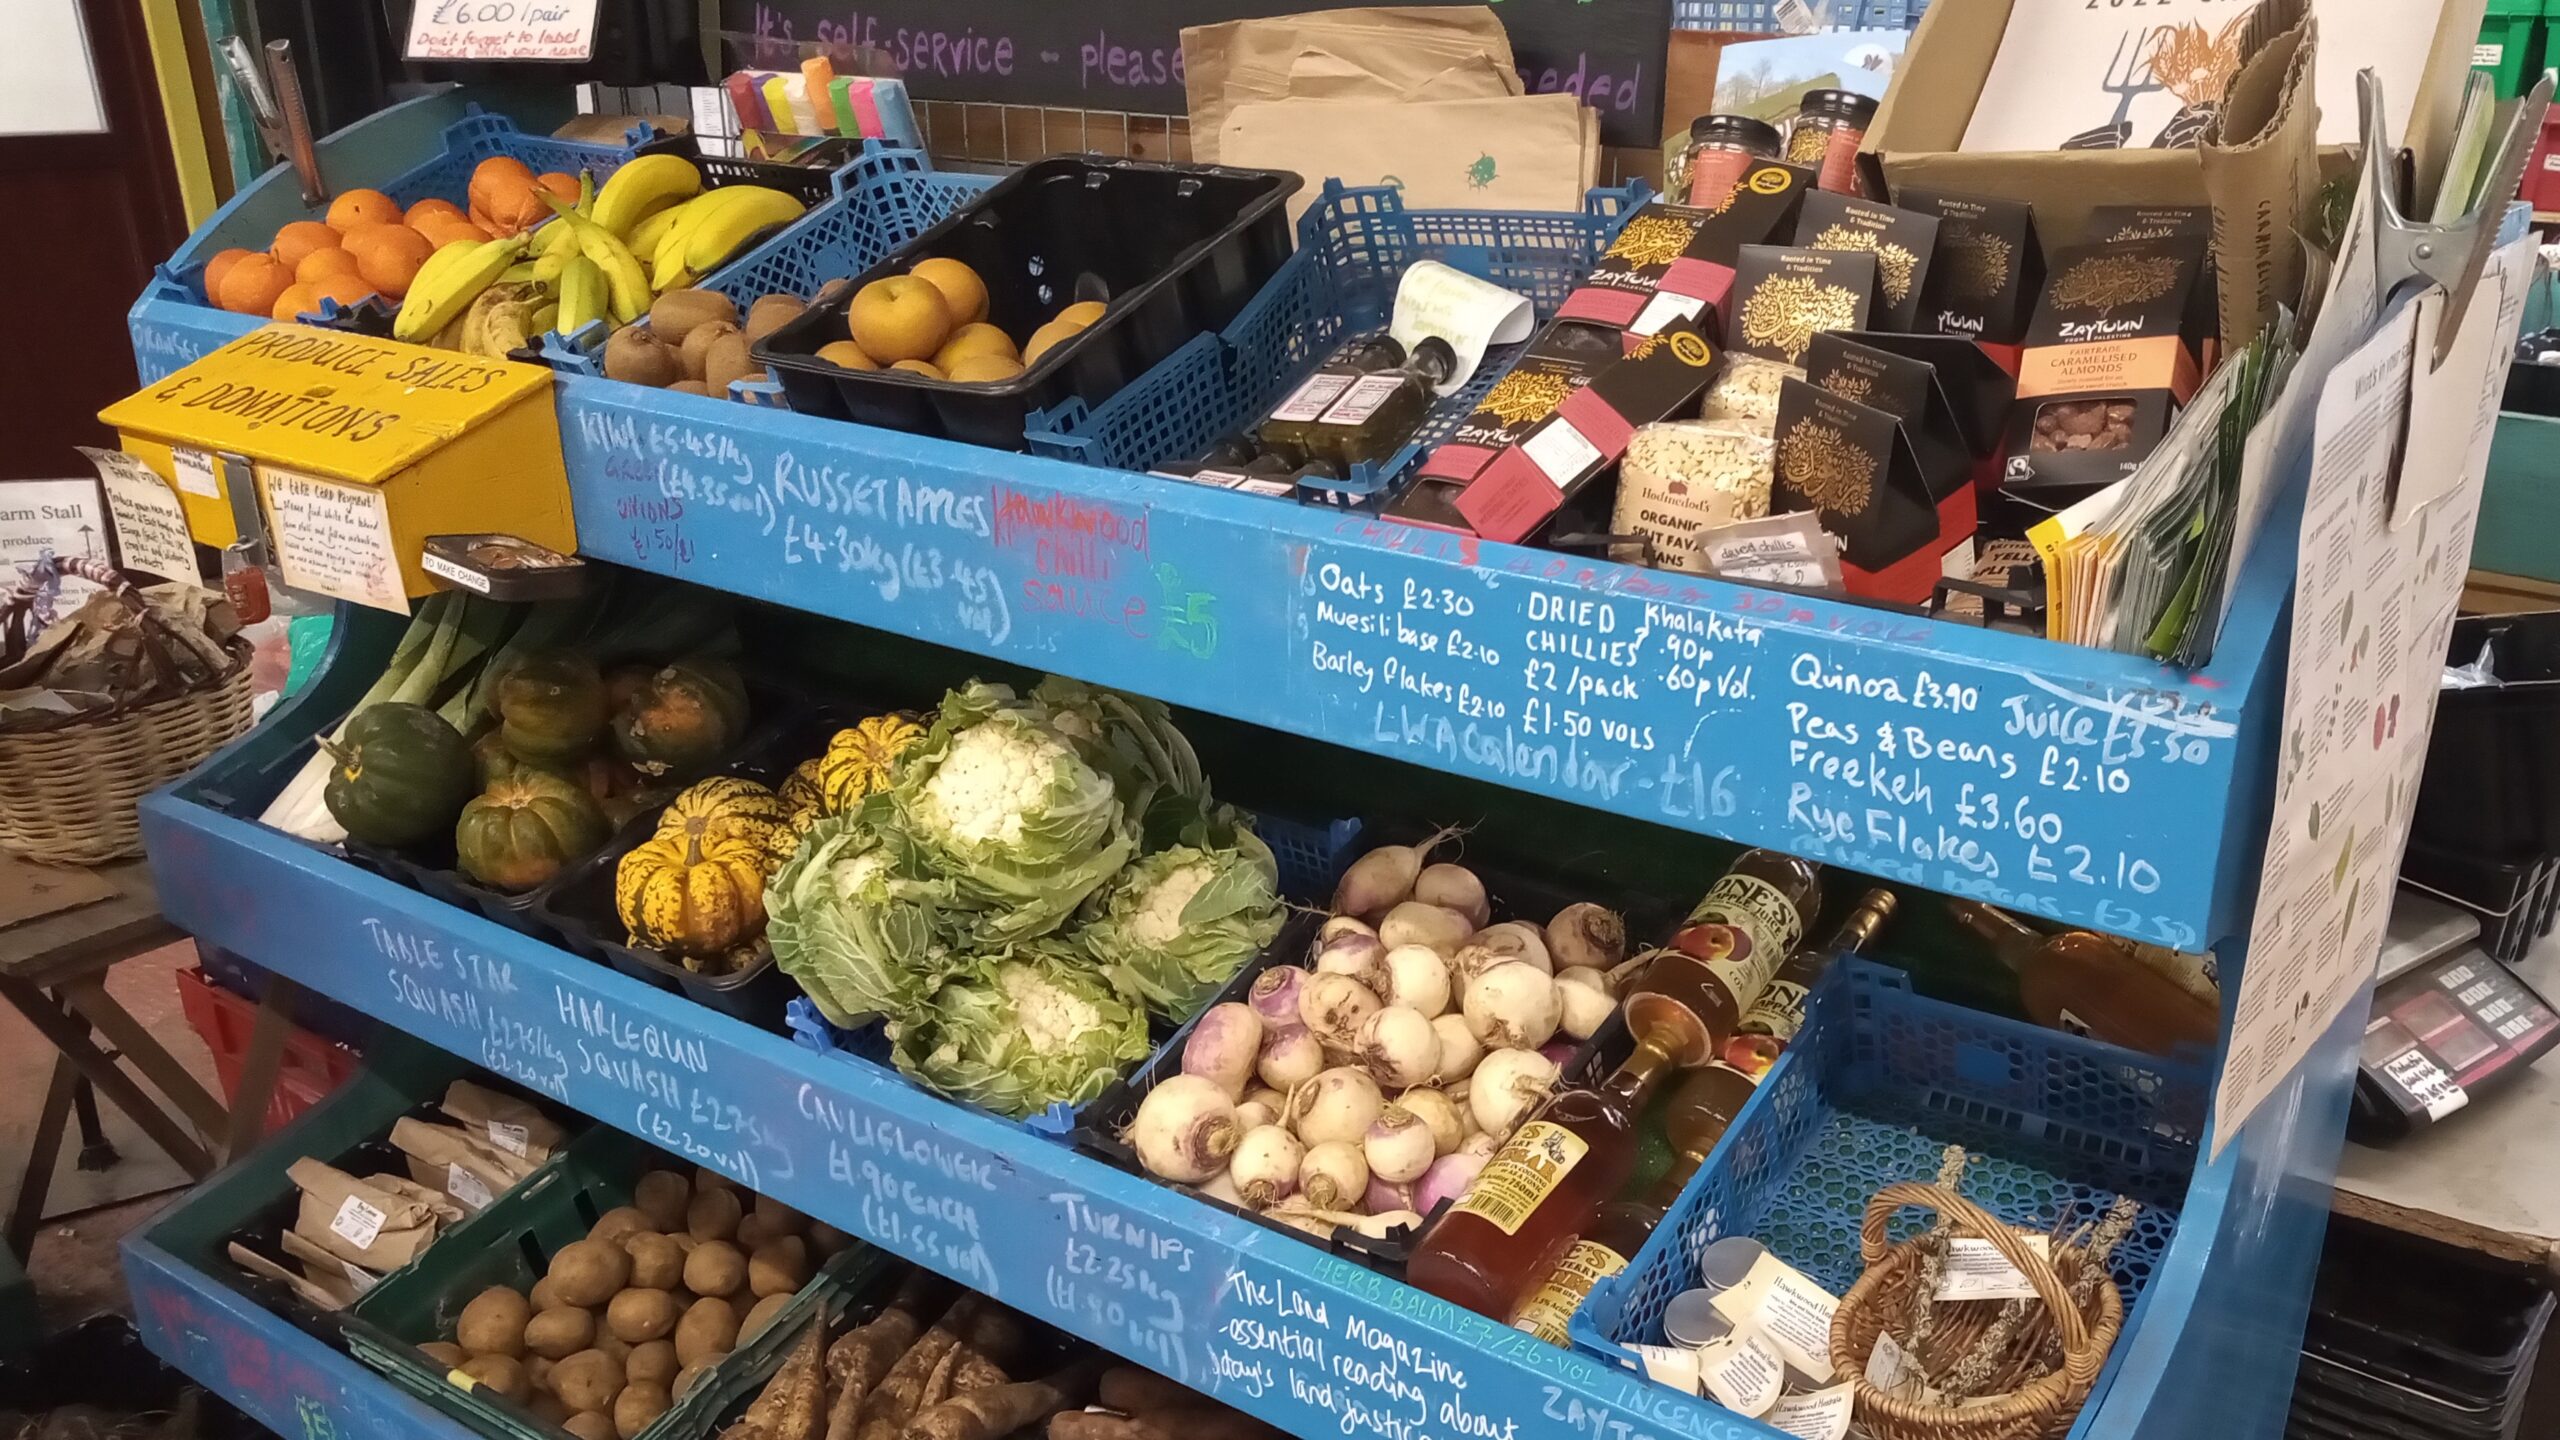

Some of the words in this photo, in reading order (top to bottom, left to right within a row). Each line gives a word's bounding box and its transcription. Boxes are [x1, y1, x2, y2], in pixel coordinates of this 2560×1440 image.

[755, 2, 794, 58] It's
[226, 330, 396, 378] PRODUCE
[385, 354, 508, 396] SALES
[2050, 352, 2138, 368] CARAMELISED
[2060, 363, 2123, 376] ALMONDS
[181, 382, 401, 443] DONATIONS
[0, 509, 36, 521] arm
[41, 503, 84, 520] Stall
[774, 449, 888, 521] RUSSET
[895, 476, 990, 537] APPLES
[2, 535, 54, 549] produce
[1639, 509, 1703, 533] ORGANIC
[425, 555, 435, 568] TO
[437, 561, 456, 577] MAKE
[457, 570, 488, 590] CHANGE
[1319, 563, 1385, 605] Oats
[1403, 577, 1474, 617] £2.30
[1527, 590, 1616, 634] DRIED
[1397, 612, 1437, 654] base
[1446, 630, 1501, 668] £2.10
[1526, 631, 1639, 669] CHILLIES
[1312, 641, 1376, 693] Barley
[1457, 681, 1506, 721] £2.10
[1524, 666, 1559, 693] £2
[1566, 669, 1641, 705] /pack
[1789, 652, 1906, 705] Quinoa
[1912, 671, 1981, 714] £3.90
[1522, 698, 1592, 738] £1.50
[1600, 717, 1656, 752] VOLS
[2000, 694, 2099, 746] Juice
[1786, 702, 1859, 747] Peas
[1877, 722, 1898, 760] &
[1901, 726, 2017, 780] Beans
[2039, 744, 2131, 795] £2.10
[1789, 740, 1934, 816] Freekeh
[1955, 786, 2064, 845] £3.60
[1787, 781, 1856, 843] Rye
[1865, 807, 2000, 879] Flakes
[2027, 843, 2162, 896] £2.10
[1710, 878, 1796, 927] ONE'S
[1715, 892, 1750, 909] APPLE
[1755, 906, 1782, 937] JUICE
[387, 967, 483, 1032] SQUASH
[455, 953, 519, 995] STAR
[1759, 999, 1797, 1019] APPLE
[577, 1037, 681, 1111] SQUASH
[1049, 1192, 1194, 1273] TURNIPS
[1310, 1256, 1384, 1302] HERB
[1388, 1286, 1458, 1331] BALM
[1774, 1275, 1819, 1312] Hawkwood
[1227, 1270, 1274, 1306] The
[1277, 1279, 1331, 1329] Land
[1346, 1314, 1468, 1389] Magazine
[1289, 1363, 1339, 1412] land
[1331, 1351, 1428, 1427] reading
[1440, 1392, 1520, 1440] about
[1774, 1402, 1817, 1414] Hawkwood
